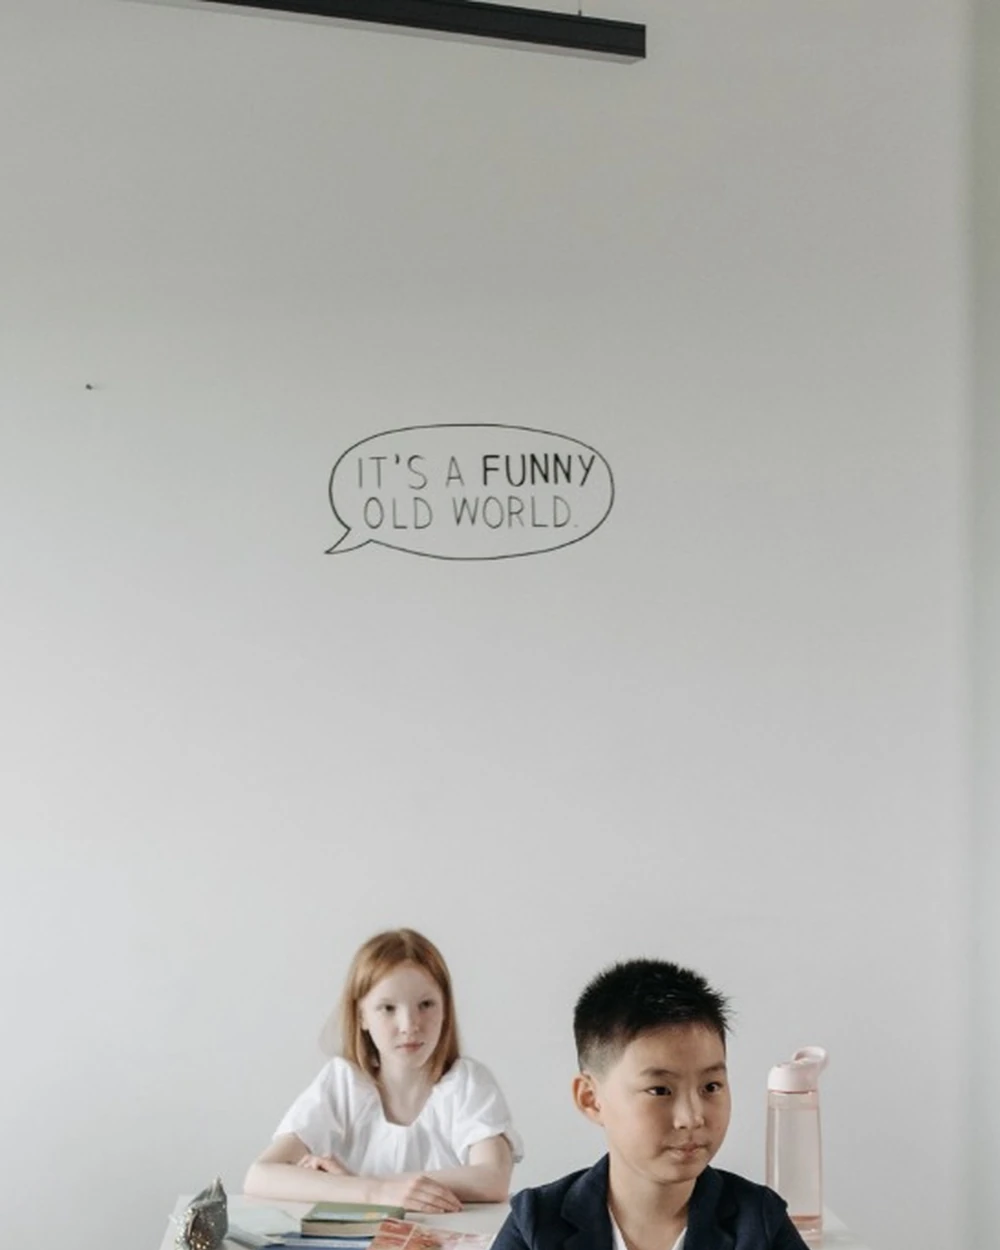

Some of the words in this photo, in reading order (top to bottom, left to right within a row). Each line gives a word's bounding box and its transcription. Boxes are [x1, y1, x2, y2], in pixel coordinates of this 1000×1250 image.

[358, 454, 427, 490] IT'S
[446, 456, 464, 487] A
[482, 453, 596, 487] FUNNY
[364, 497, 433, 530] OLD
